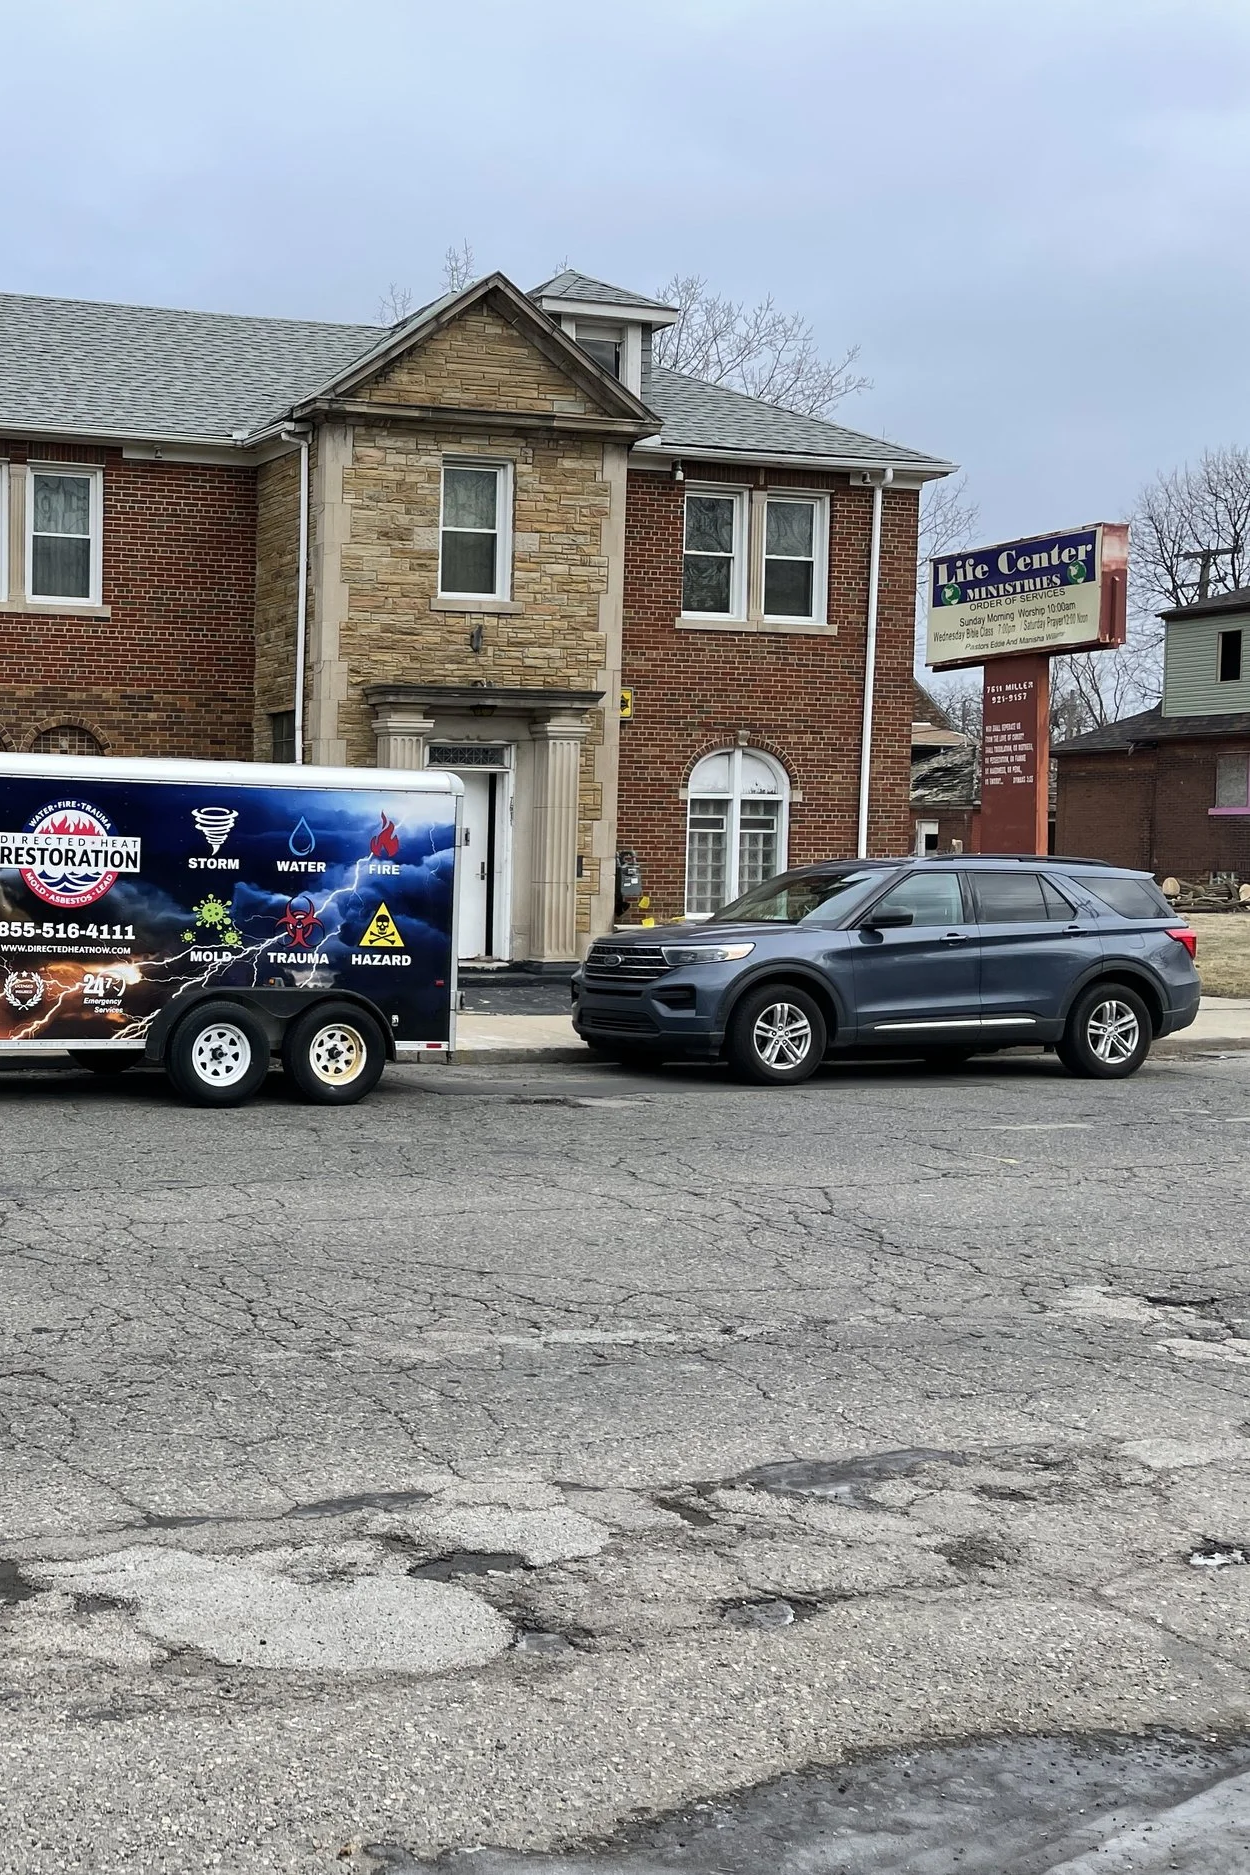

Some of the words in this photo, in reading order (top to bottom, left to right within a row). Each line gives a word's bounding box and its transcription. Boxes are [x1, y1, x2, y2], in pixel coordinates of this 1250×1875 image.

[936, 558, 989, 587] Life
[997, 543, 1093, 575] Center
[966, 573, 1061, 601] MINISTRIES
[969, 596, 1003, 611] ORDER
[1005, 594, 1018, 606] OF
[1020, 588, 1066, 603] SERVICES
[959, 614, 986, 628] Sunday
[987, 611, 1015, 623] Morning
[1017, 605, 1045, 618] Worship
[1047, 601, 1076, 614] 10:00am
[933, 629, 965, 643] Wednesday
[966, 627, 979, 639] Bible
[979, 626, 994, 638] Class
[1023, 618, 1046, 632] Saturday
[1006, 637, 1018, 645] And
[1005, 681, 1034, 691] MILLER
[991, 692, 1027, 704] 921-9157
[28, 804, 55, 828] WATER
[57, 800, 77, 809] FIRE
[80, 802, 112, 830] TRAUMA
[0, 835, 86, 847] DIRECTED
[100, 839, 139, 849] HEAT
[0, 846, 138, 869] RESTORATION
[188, 858, 240, 870] STORM
[276, 861, 327, 873] WATER
[368, 864, 400, 876] FIRE
[25, 871, 47, 896] MOLD
[48, 894, 93, 905] ASBESTOS
[95, 874, 113, 894] LEAD
[0, 944, 131, 955] WWW.DIRECTEDHEATNOW.COM
[190, 951, 233, 963] MOLD
[267, 952, 330, 965] TRAUMA
[351, 954, 412, 966] HAZARD
[83, 997, 123, 1006] Emergency
[94, 1006, 124, 1014] Services
